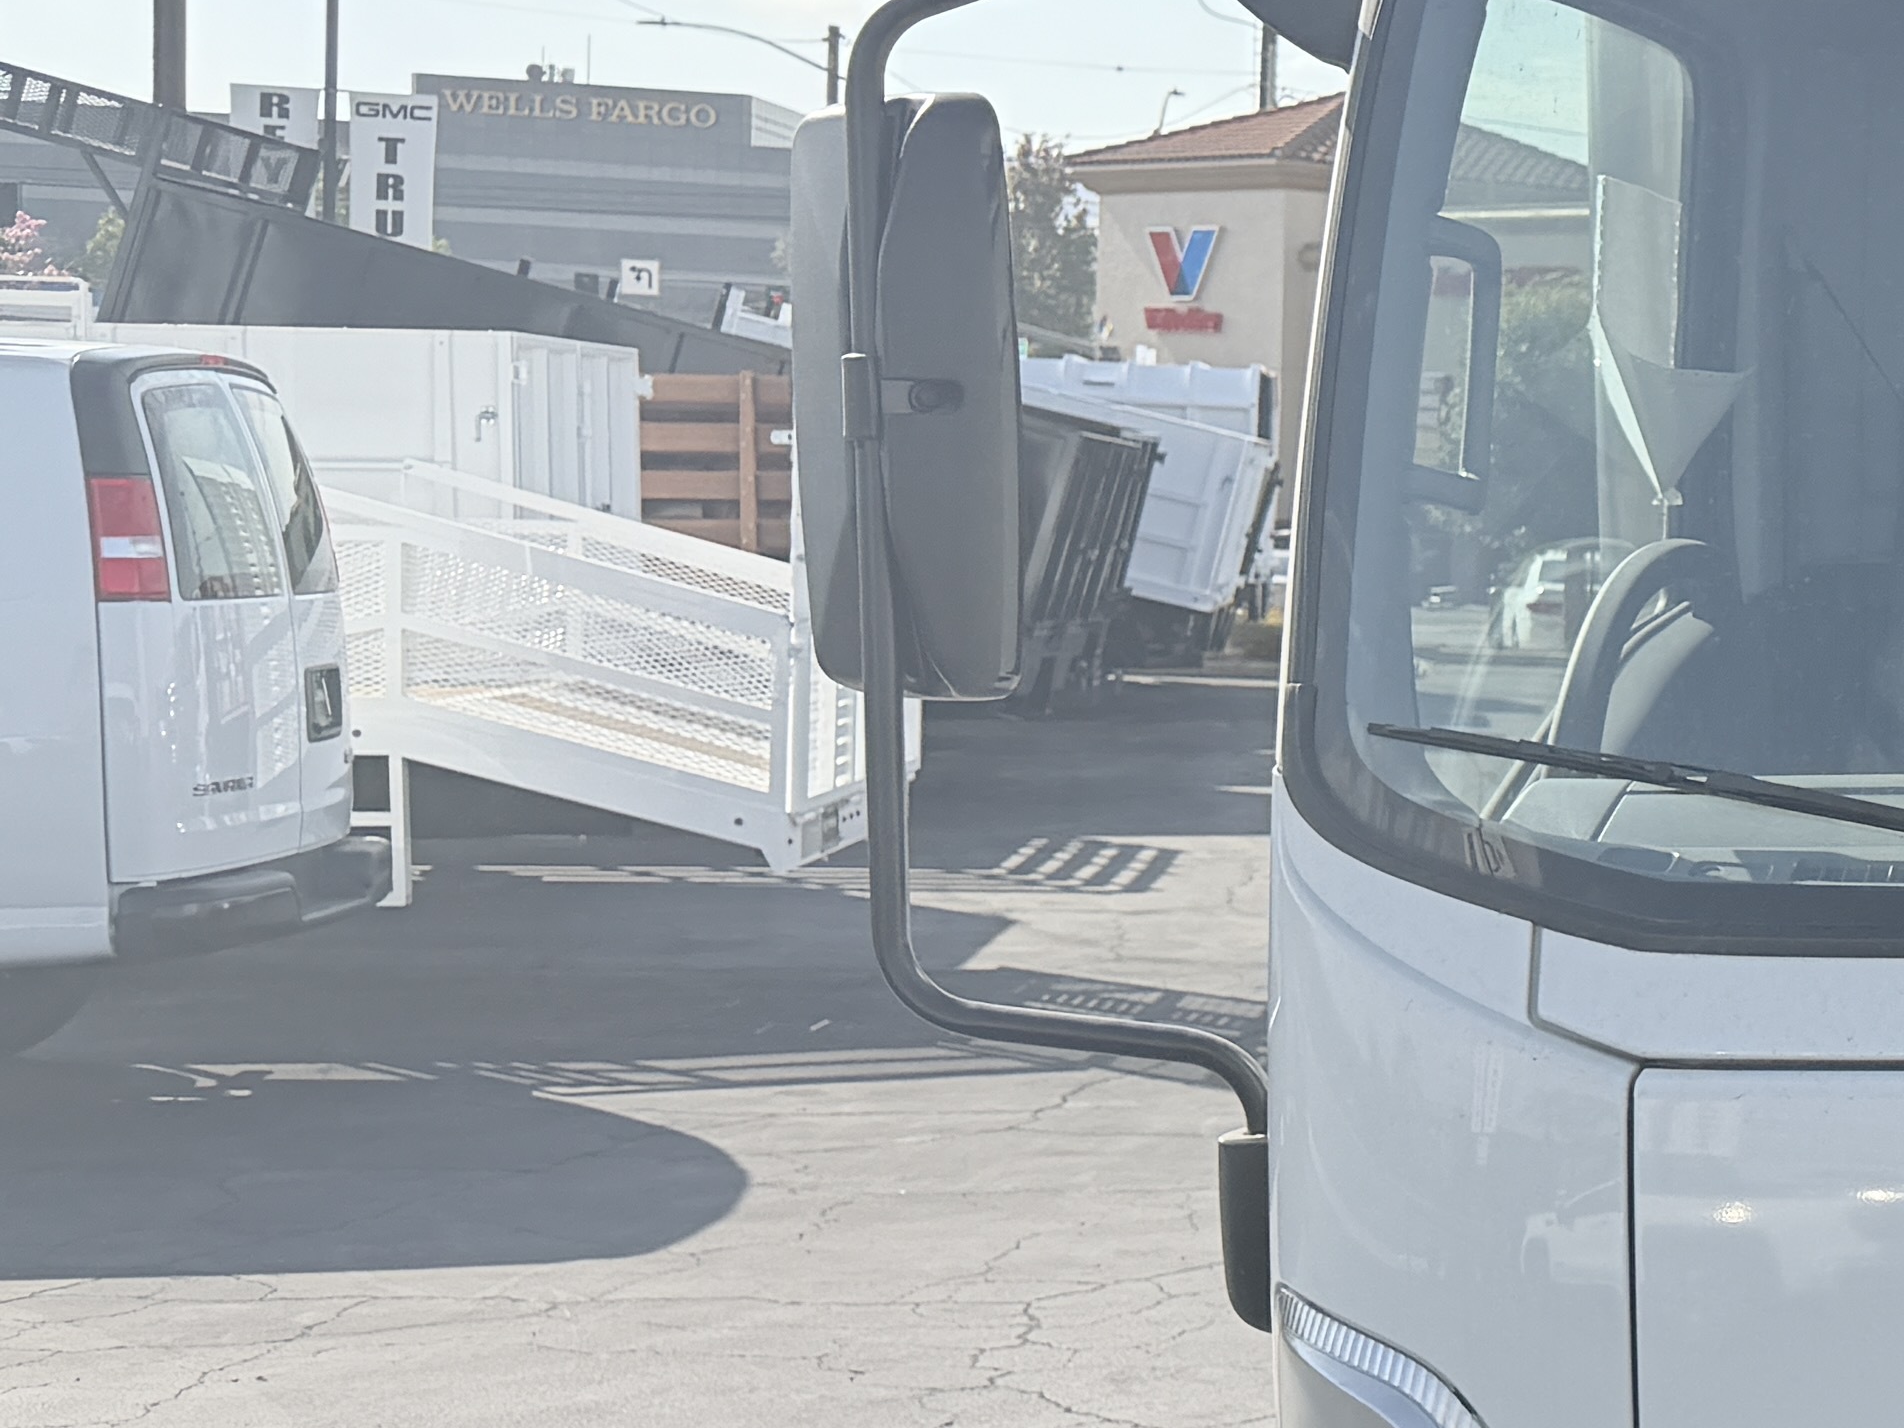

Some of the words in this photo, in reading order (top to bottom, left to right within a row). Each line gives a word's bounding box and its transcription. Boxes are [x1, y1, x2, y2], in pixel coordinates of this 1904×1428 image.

[355, 101, 433, 122] GMC
[442, 88, 578, 120] WELLS
[589, 96, 718, 129] FARGO
